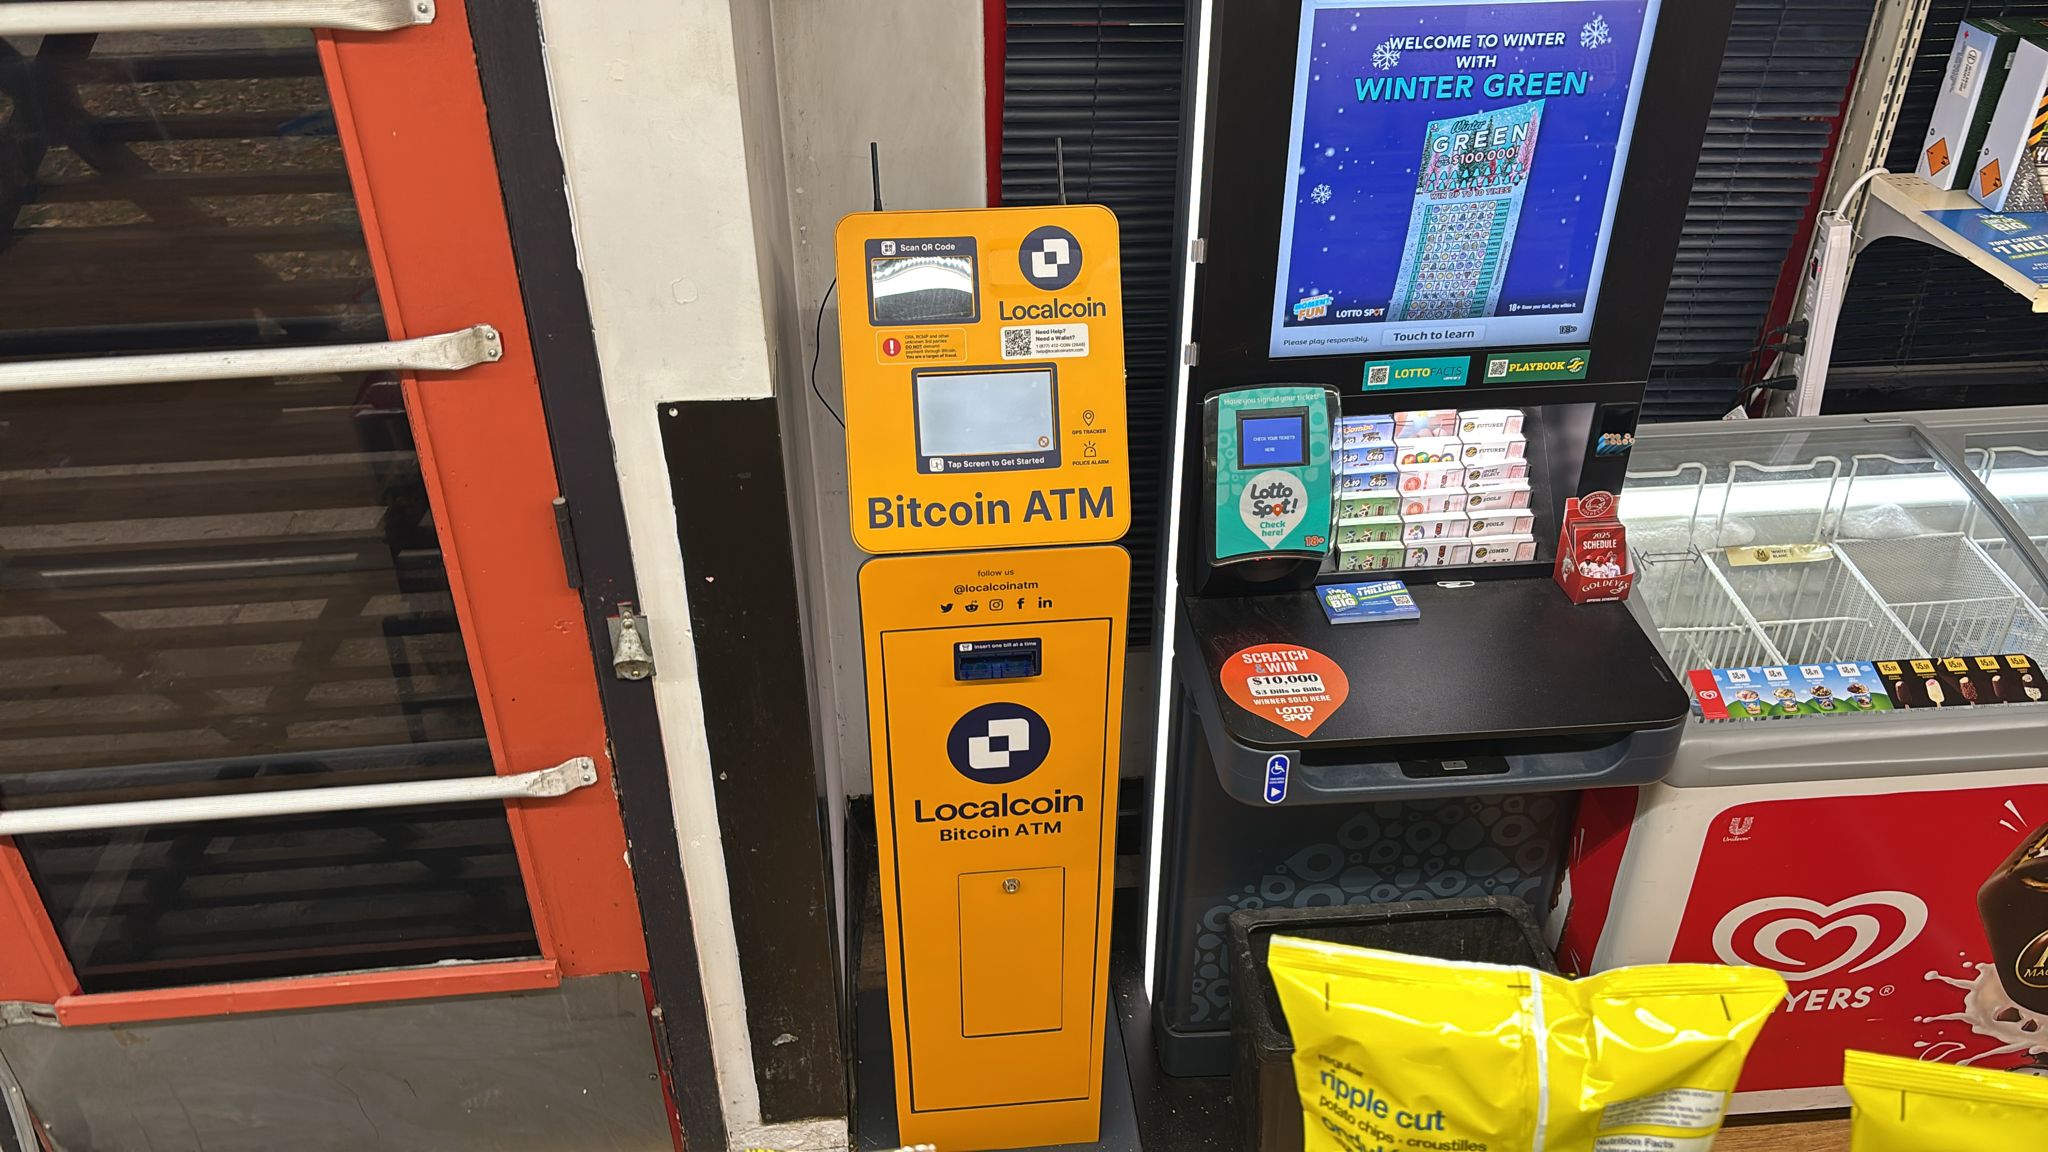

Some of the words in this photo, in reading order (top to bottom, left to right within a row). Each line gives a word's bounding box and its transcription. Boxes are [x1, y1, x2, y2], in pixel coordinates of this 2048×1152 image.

[1389, 35, 1471, 50] WELCOME
[1476, 34, 1498, 48] TO
[1503, 32, 1565, 47] WINTER
[1456, 55, 1497, 69] WITH
[1355, 75, 1474, 101] WINTER
[1483, 71, 1588, 98] GREEN
[1451, 120, 1486, 134] Winter
[1433, 123, 1530, 153] GREEN
[1452, 147, 1520, 165] $100,000!
[1462, 190, 1473, 198] TO
[900, 244, 915, 252] Scan
[917, 243, 933, 252] QR
[935, 242, 955, 251] Code
[999, 297, 1106, 321] Localcoin
[1298, 306, 1327, 320] FUN
[1336, 309, 1361, 318] LOTTO
[1364, 308, 1385, 317] SPOT
[1050, 328, 1067, 336] Help?
[1393, 332, 1427, 341] Touch
[1430, 331, 1442, 340] to
[1445, 330, 1475, 339] learn
[1326, 336, 1369, 344] responsibly.
[1508, 361, 1566, 373] PLAYBOOK
[1243, 397, 1257, 406] you
[1279, 395, 1297, 403] your
[947, 461, 961, 470] Tap
[963, 459, 990, 468] Screen
[992, 458, 1000, 467] to
[1001, 458, 1014, 466] Get
[1015, 456, 1045, 466] Started
[1250, 482, 1293, 499] Lotto
[867, 491, 1010, 529] Bitcoin
[1023, 486, 1114, 523] ATM
[1252, 498, 1298, 518] Spot!
[1260, 521, 1286, 529] Check
[1583, 539, 1617, 550] SCHEDULE
[977, 569, 1002, 577] follow
[953, 581, 1039, 595] @localcoinatm
[1363, 583, 1402, 595] MILLION!
[1581, 579, 1630, 593] GOLDEYES
[1331, 598, 1356, 608] BIG
[1241, 650, 1309, 664] SCRATCH
[1265, 661, 1298, 673] WIN
[1252, 674, 1319, 686] $10,000
[1253, 697, 1287, 705] WINNER
[1287, 696, 1309, 704] SOLD
[1309, 694, 1332, 702] HERE
[1275, 705, 1314, 715] LOTTO
[1282, 713, 1313, 722] SPOT
[914, 789, 1084, 823] Localcoin
[940, 825, 1009, 841] Bitcoin
[1015, 821, 1062, 836] ATM
[1318, 1054, 1364, 1078] regular
[1320, 1068, 1389, 1119] ripple
[1395, 1110, 1446, 1131] cut
[1320, 1096, 1356, 1125] potato
[1357, 1118, 1394, 1144] chips
[1406, 1137, 1487, 1152] croustilles
[1595, 1137, 1642, 1146] Nutrition
[1644, 1138, 1674, 1149] Facts
